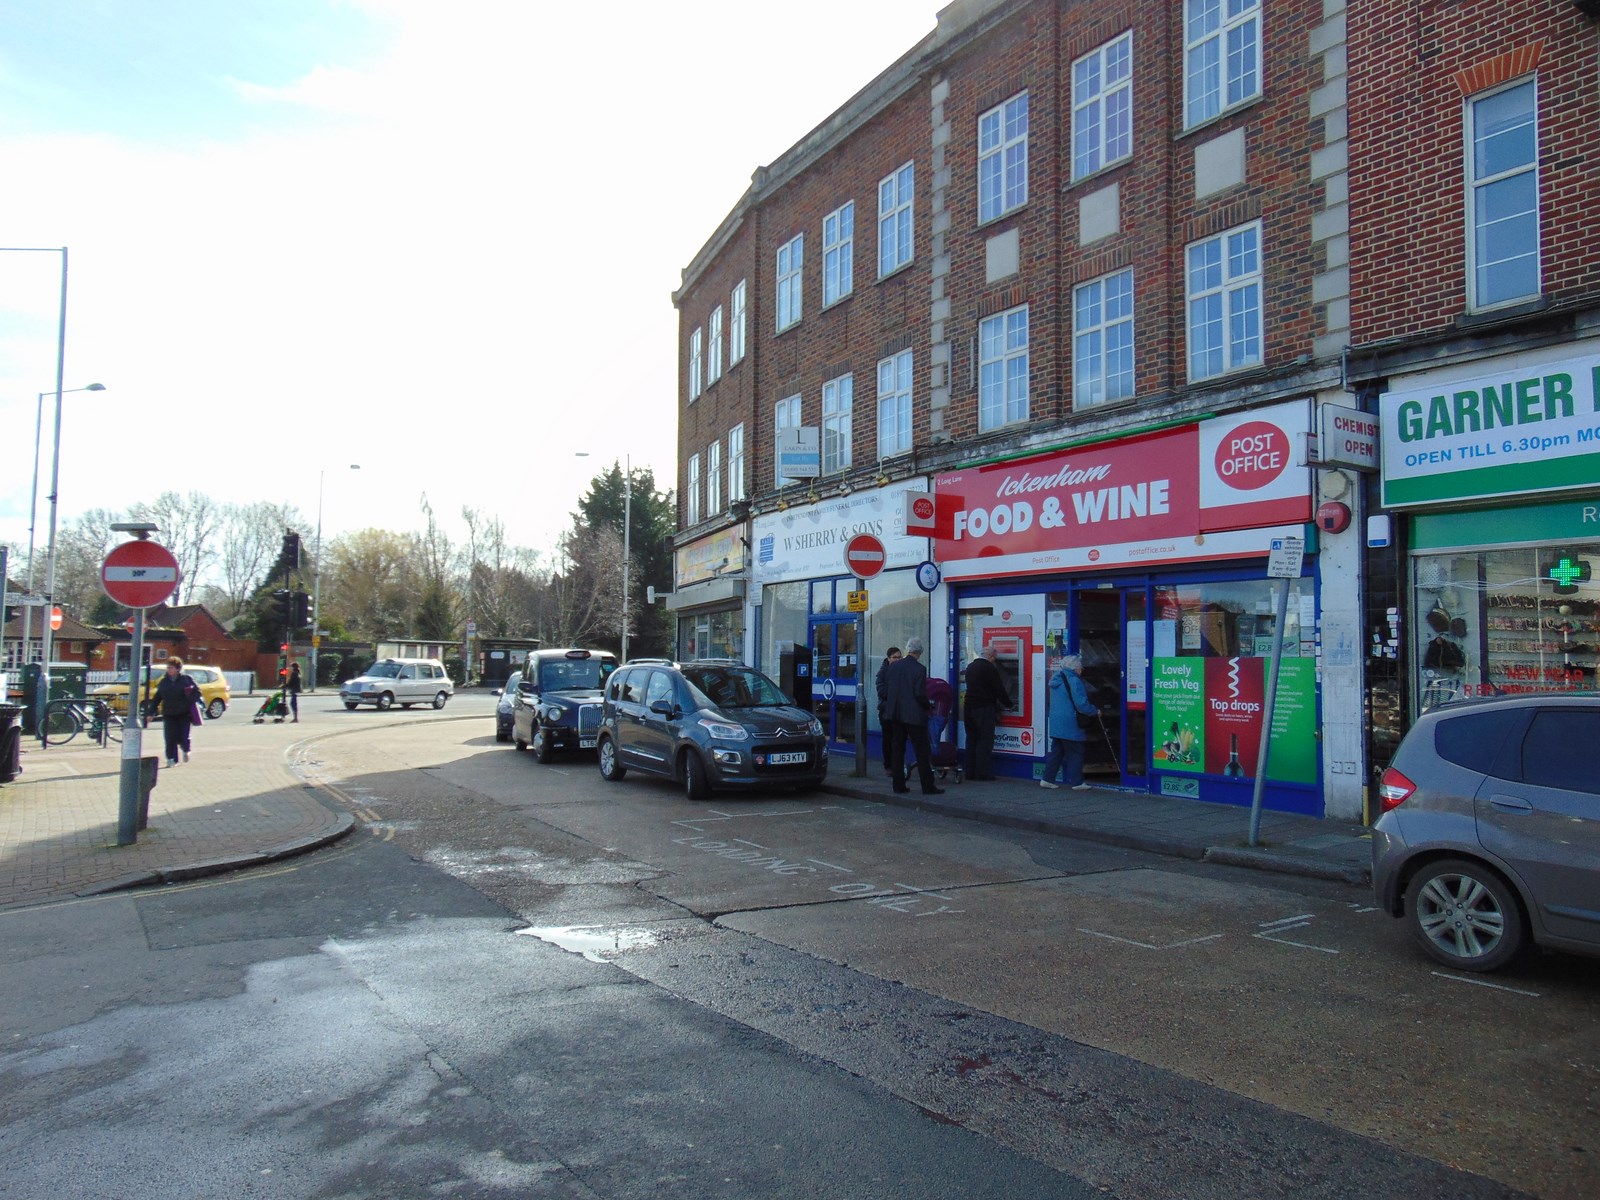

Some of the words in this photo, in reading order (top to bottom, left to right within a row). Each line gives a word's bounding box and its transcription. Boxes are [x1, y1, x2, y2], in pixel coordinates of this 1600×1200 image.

[1397, 372, 1574, 443] GARNER
[1334, 416, 1380, 437] CHEMIST
[1231, 432, 1275, 456] POST
[1345, 439, 1373, 457] OPEN
[1405, 450, 1452, 467] OPEN
[1458, 443, 1496, 459] TILL
[1502, 433, 1570, 454] 6.30pm
[1221, 451, 1281, 477] OFFICE
[996, 463, 1112, 498] Ickenham
[914, 507, 932, 516] OFFICE
[953, 501, 1034, 541] FOOD
[1039, 496, 1066, 529] &
[1071, 479, 1170, 525] WINE
[783, 537, 794, 552] W
[795, 527, 838, 551] SHERRY
[840, 526, 849, 543] &
[852, 519, 884, 537] SONS
[1129, 545, 1176, 558] postoffice.co.uk
[1162, 664, 1191, 678] Lovely
[1543, 668, 1584, 683] YEAR
[1154, 678, 1179, 689] Fresh
[1181, 679, 1199, 693] Veg
[1209, 698, 1229, 713] Top
[1230, 699, 1260, 714] drops
[771, 754, 791, 763] LJ63
[791, 753, 805, 762] KTV
[671, 836, 817, 876] LOADING
[828, 882, 965, 917] ONLY
